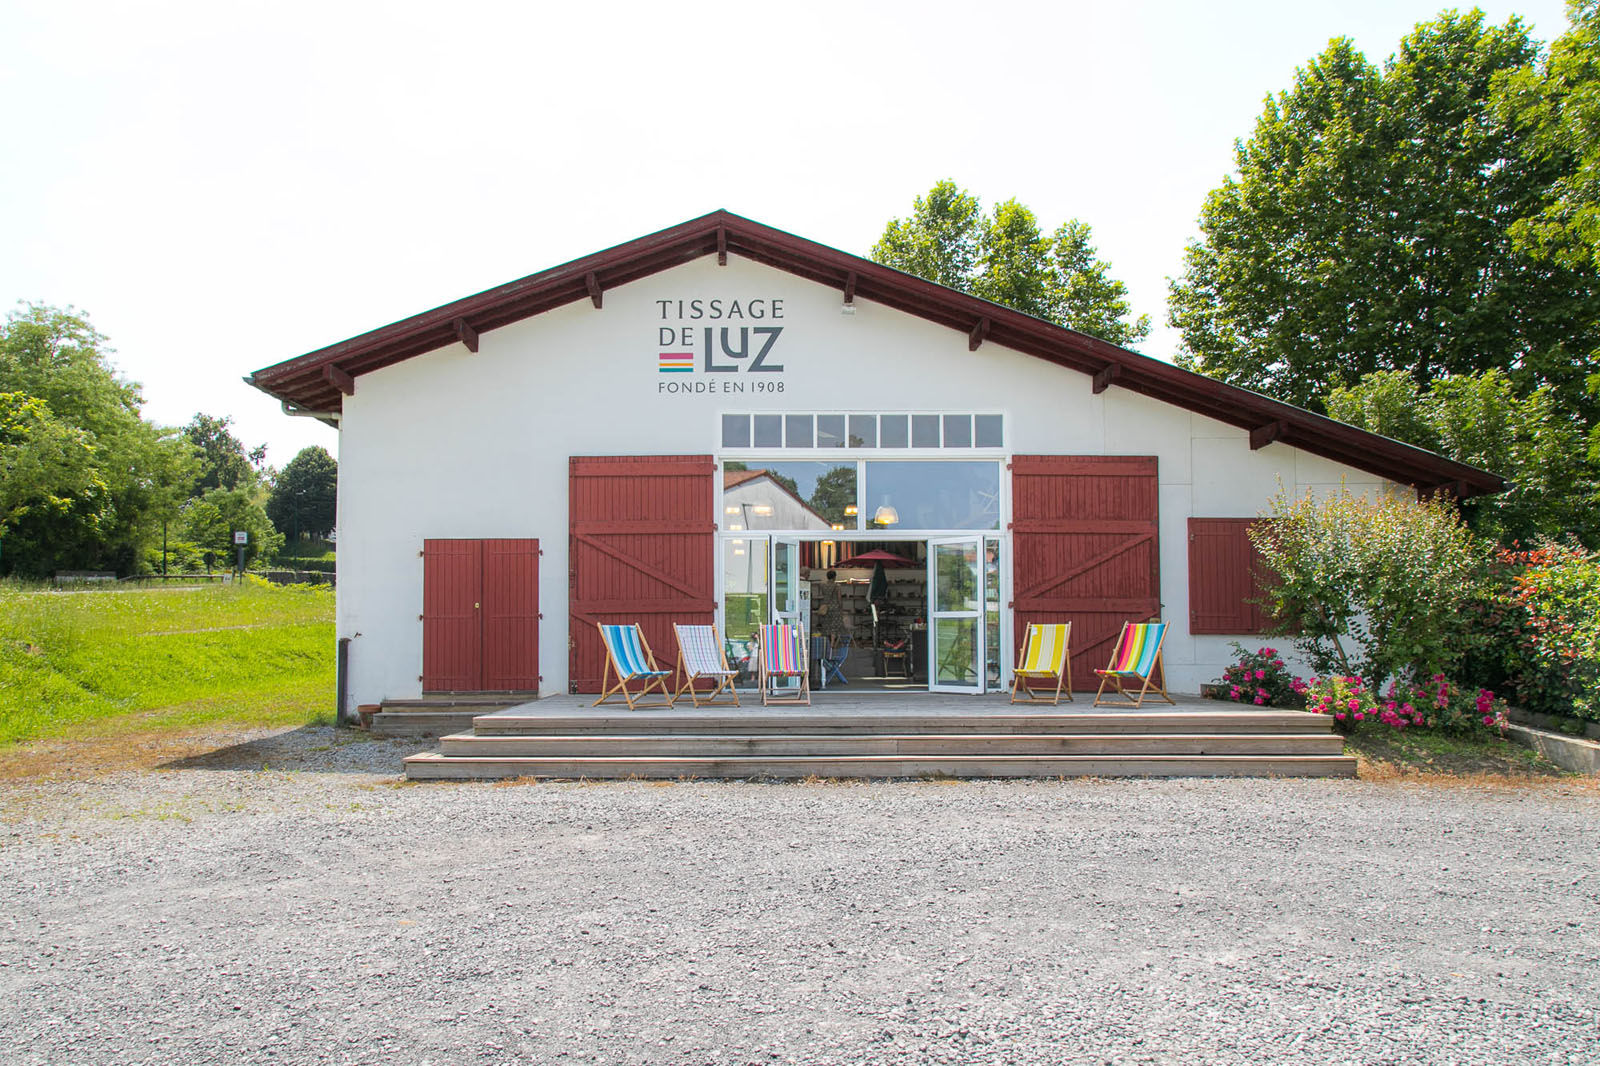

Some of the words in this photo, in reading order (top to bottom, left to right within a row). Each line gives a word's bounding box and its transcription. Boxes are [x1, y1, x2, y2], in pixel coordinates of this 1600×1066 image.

[656, 299, 784, 320] TISSAGE
[659, 327, 694, 346] DE
[704, 326, 785, 373] LUZ
[658, 379, 716, 393] FONDÉ
[723, 382, 744, 393] EN
[751, 381, 785, 393] 1908
